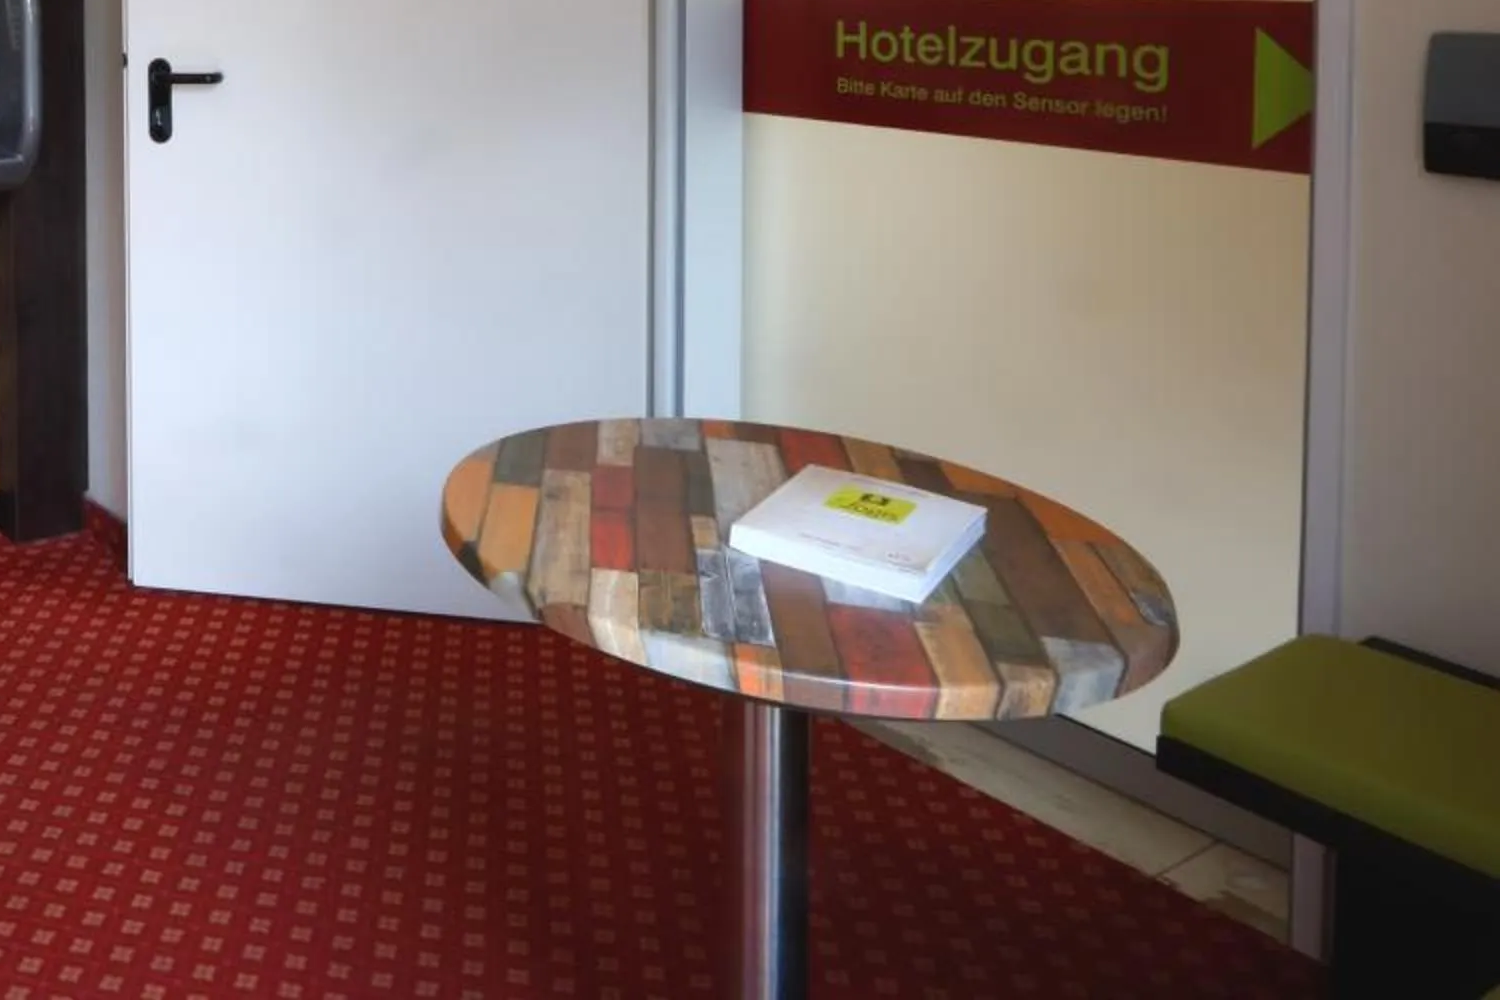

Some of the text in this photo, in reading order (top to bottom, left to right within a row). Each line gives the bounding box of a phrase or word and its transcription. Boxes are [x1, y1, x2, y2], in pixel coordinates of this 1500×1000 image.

[835, 19, 1170, 93] Hotelzugang
[836, 76, 1168, 124] Bitte Karte auf den Sensor legen!
